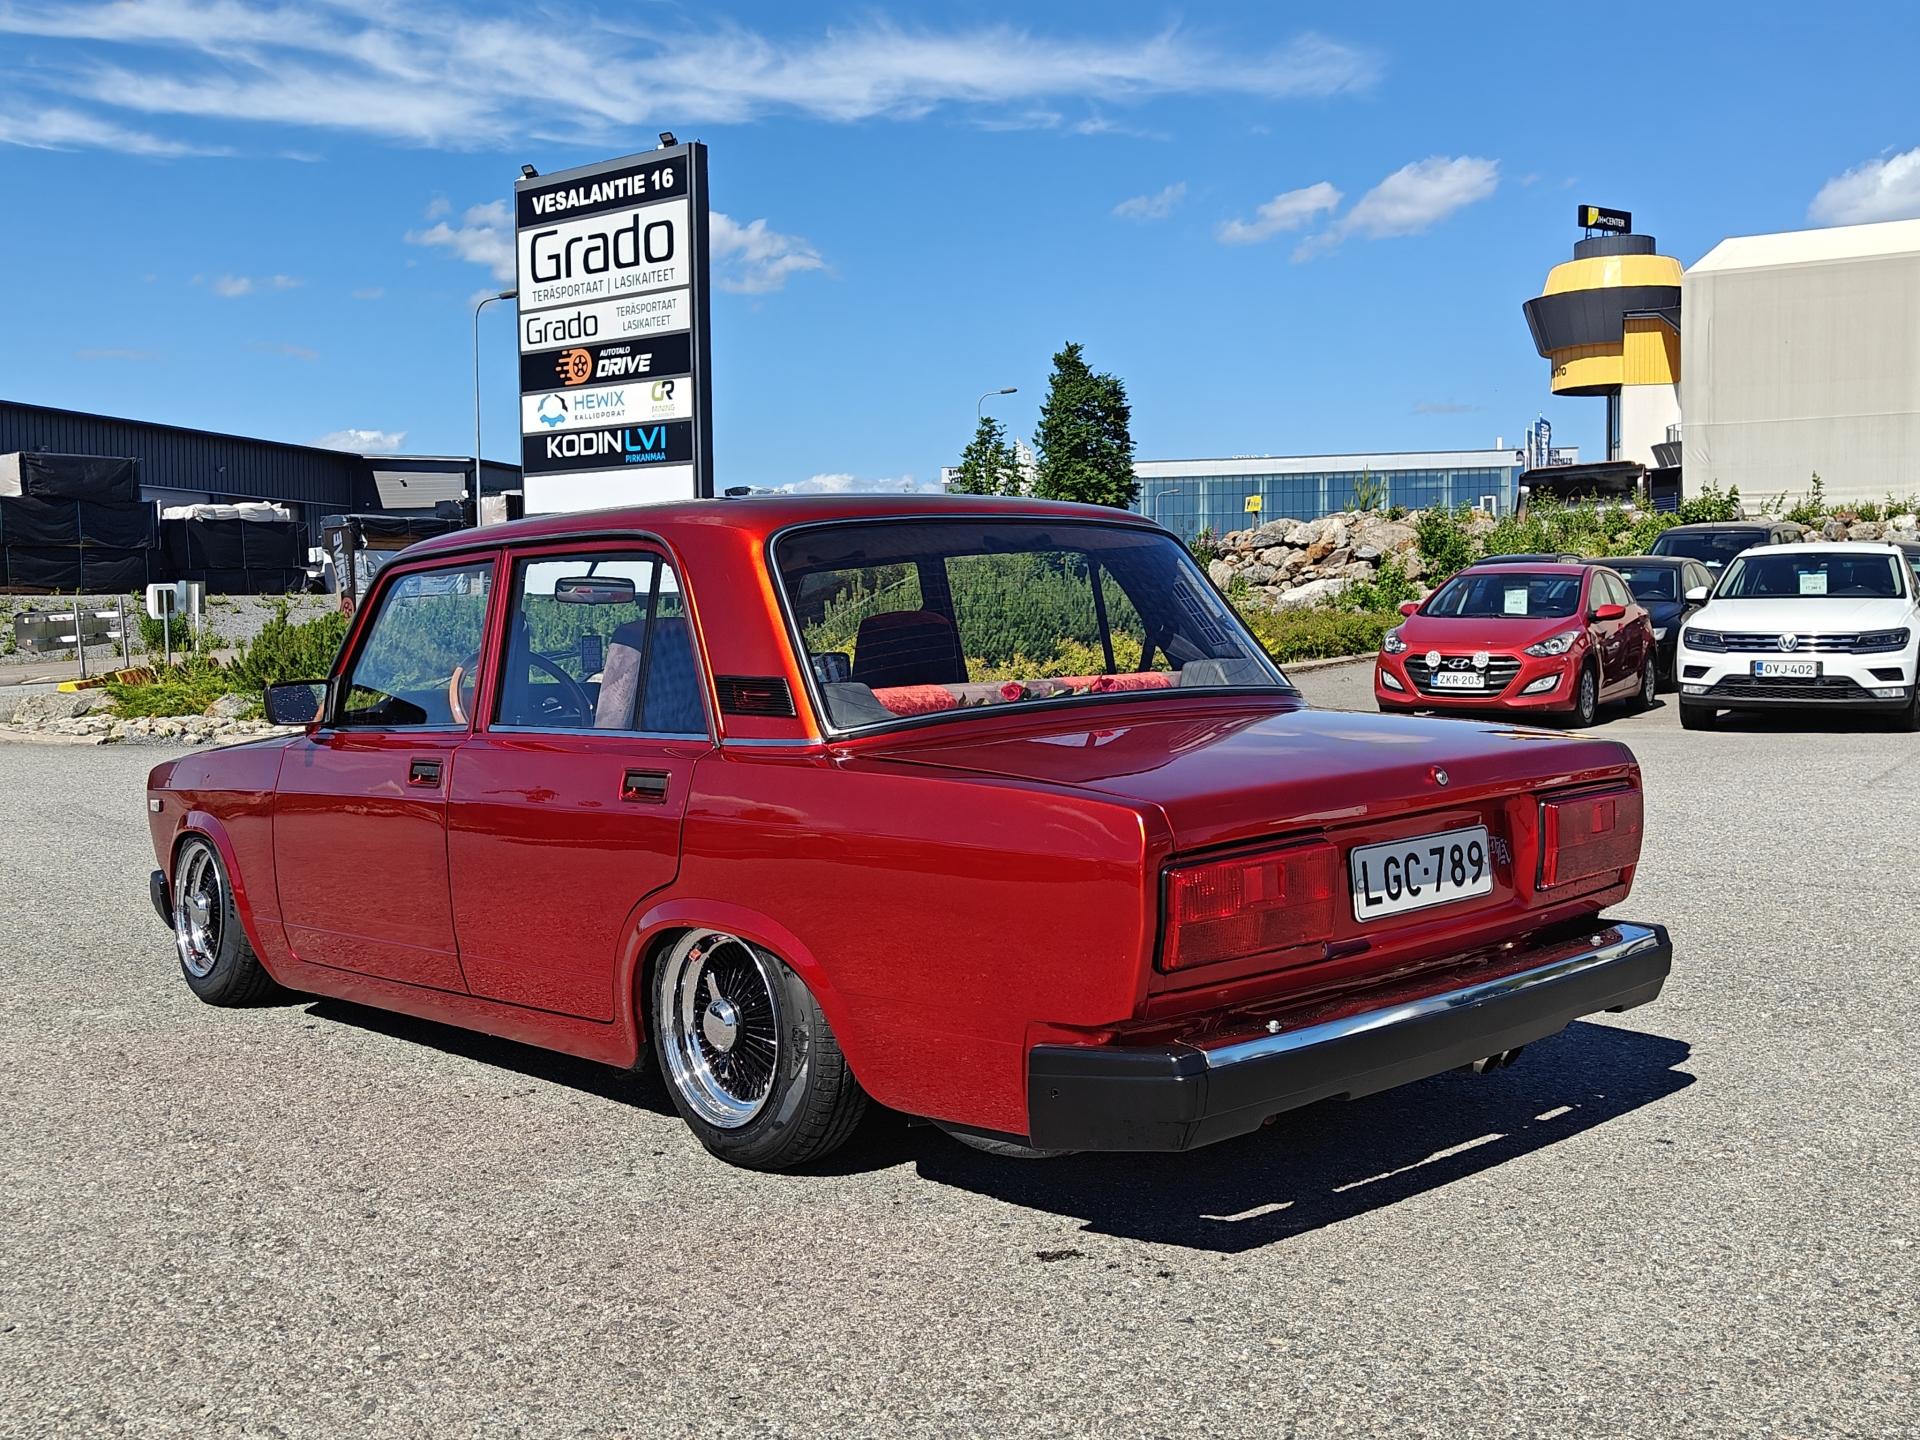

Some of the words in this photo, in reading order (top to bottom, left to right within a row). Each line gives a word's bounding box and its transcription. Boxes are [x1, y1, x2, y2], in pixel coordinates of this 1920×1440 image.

[532, 174, 645, 215] VESALANTIE
[651, 167, 674, 191] 16
[530, 213, 674, 284] Grado
[532, 280, 604, 302] TERÄSPORTAAT
[614, 267, 675, 289] LASIKAITEET
[526, 311, 598, 345] Grado
[623, 314, 671, 331] LASIKAITEET
[600, 346, 630, 357] AUTOTALO
[596, 353, 652, 377] DRIVE
[574, 390, 625, 411] HEWIX
[574, 410, 625, 420] KALLIOPORAT
[625, 452, 666, 463] PIRKANMAA
[1439, 674, 1482, 685] ZKR-203
[1765, 664, 1813, 675] OVJ-402
[1361, 840, 1485, 907] LGC-789
